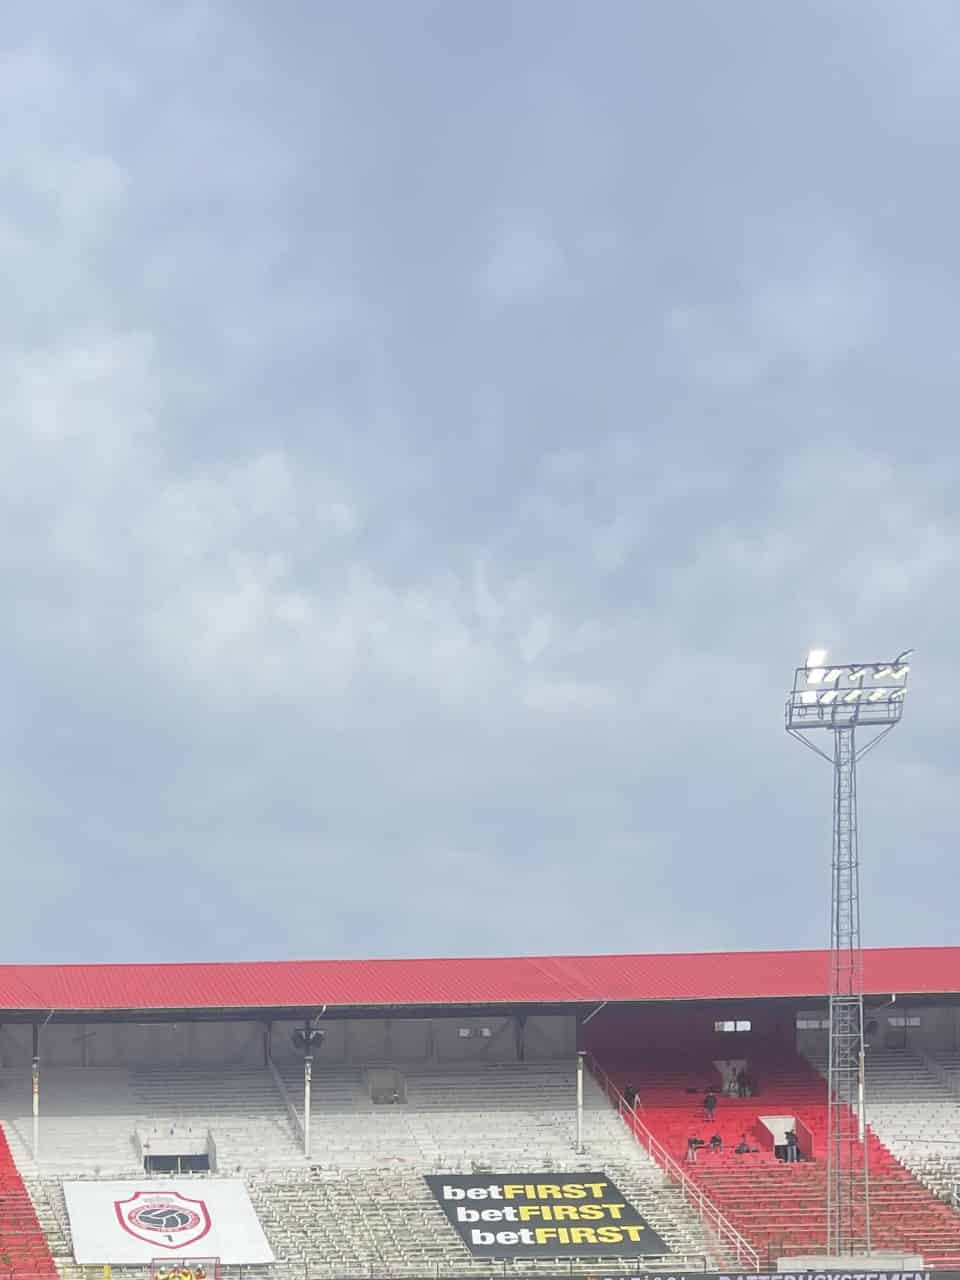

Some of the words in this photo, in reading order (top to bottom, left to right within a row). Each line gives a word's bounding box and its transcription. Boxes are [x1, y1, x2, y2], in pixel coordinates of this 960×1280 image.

[443, 1182, 607, 1200] betFIRST
[456, 1204, 624, 1222] betFIRST
[471, 1226, 644, 1245] betFIRST
